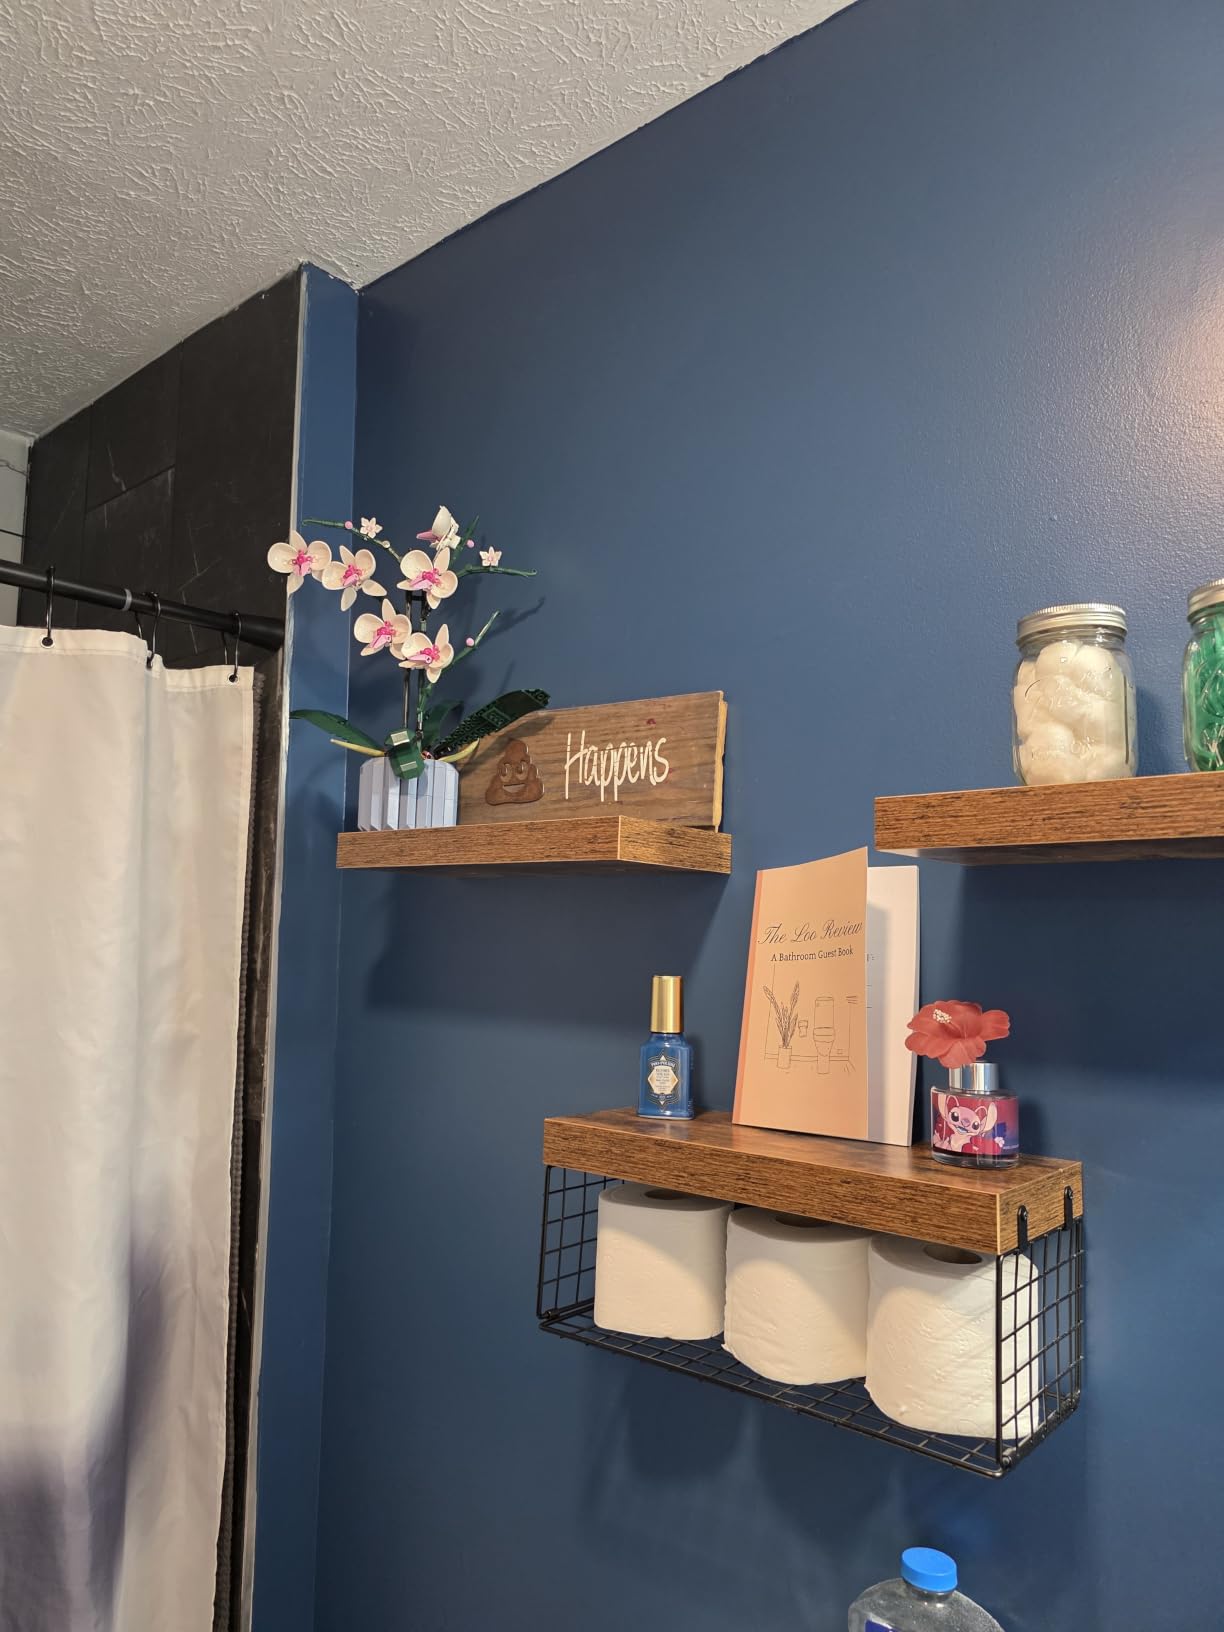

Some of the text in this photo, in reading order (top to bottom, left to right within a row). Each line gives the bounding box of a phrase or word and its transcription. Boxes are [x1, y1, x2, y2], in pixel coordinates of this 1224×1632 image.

[564, 729, 670, 802] Happens
[757, 919, 863, 945] The Loo Review
[770, 946, 853, 962] A Bathroom Guest Book
